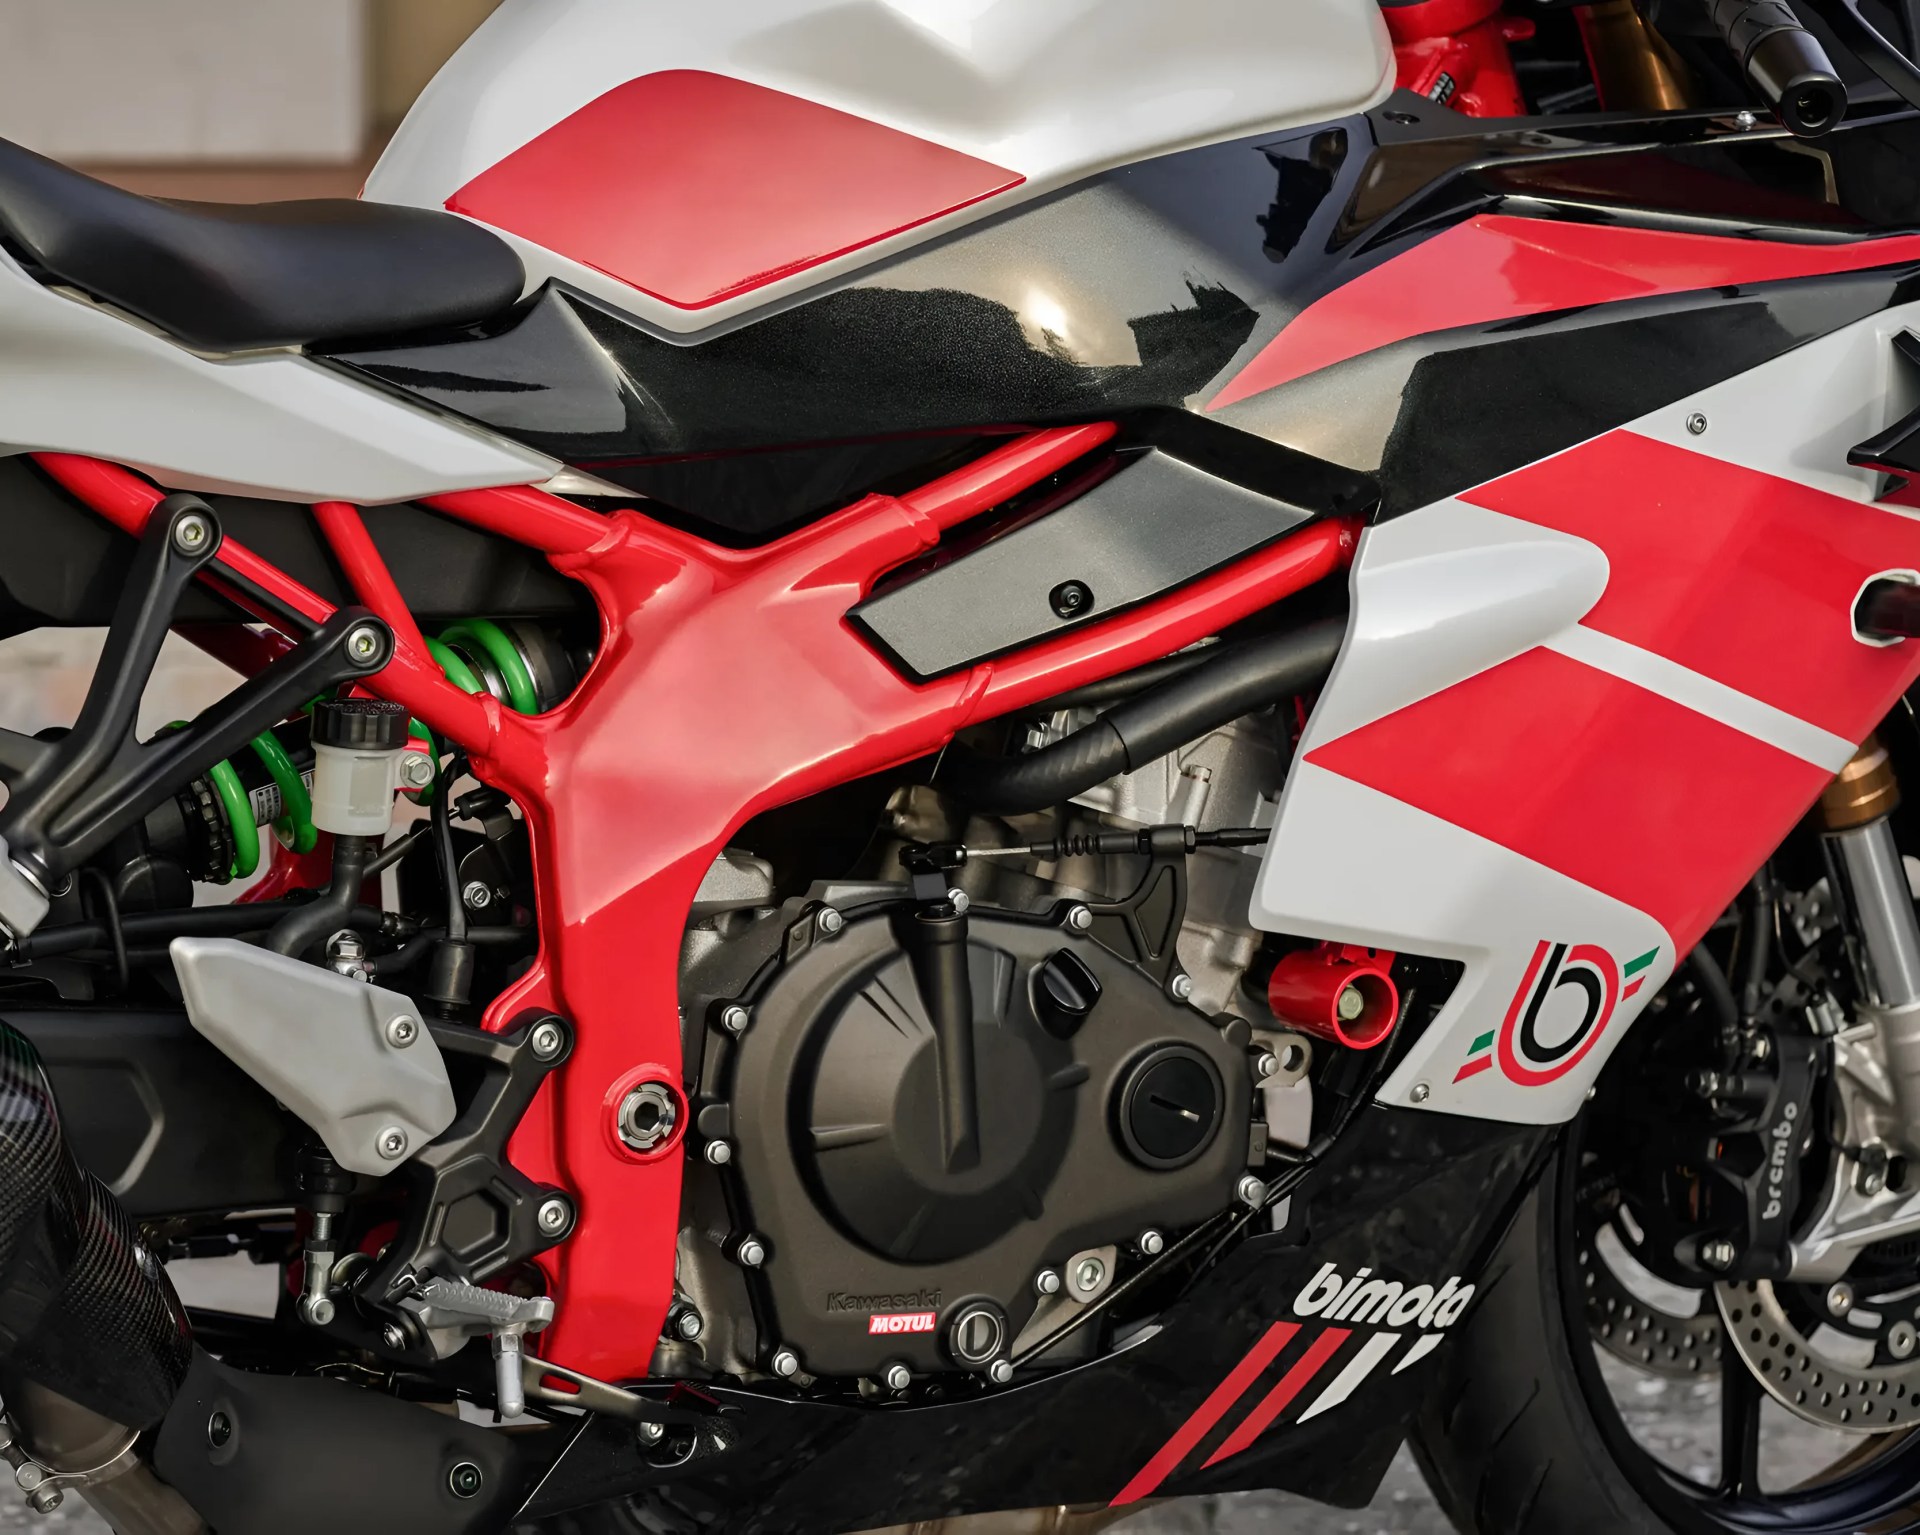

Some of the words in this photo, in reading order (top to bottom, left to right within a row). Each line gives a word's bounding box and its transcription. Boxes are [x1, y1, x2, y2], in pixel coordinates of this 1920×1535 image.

[1762, 1102, 1797, 1219] brembo
[826, 1289, 942, 1312] Kawasaki
[1293, 1262, 1475, 1328] bimota
[870, 1314, 935, 1333] MOTUL
